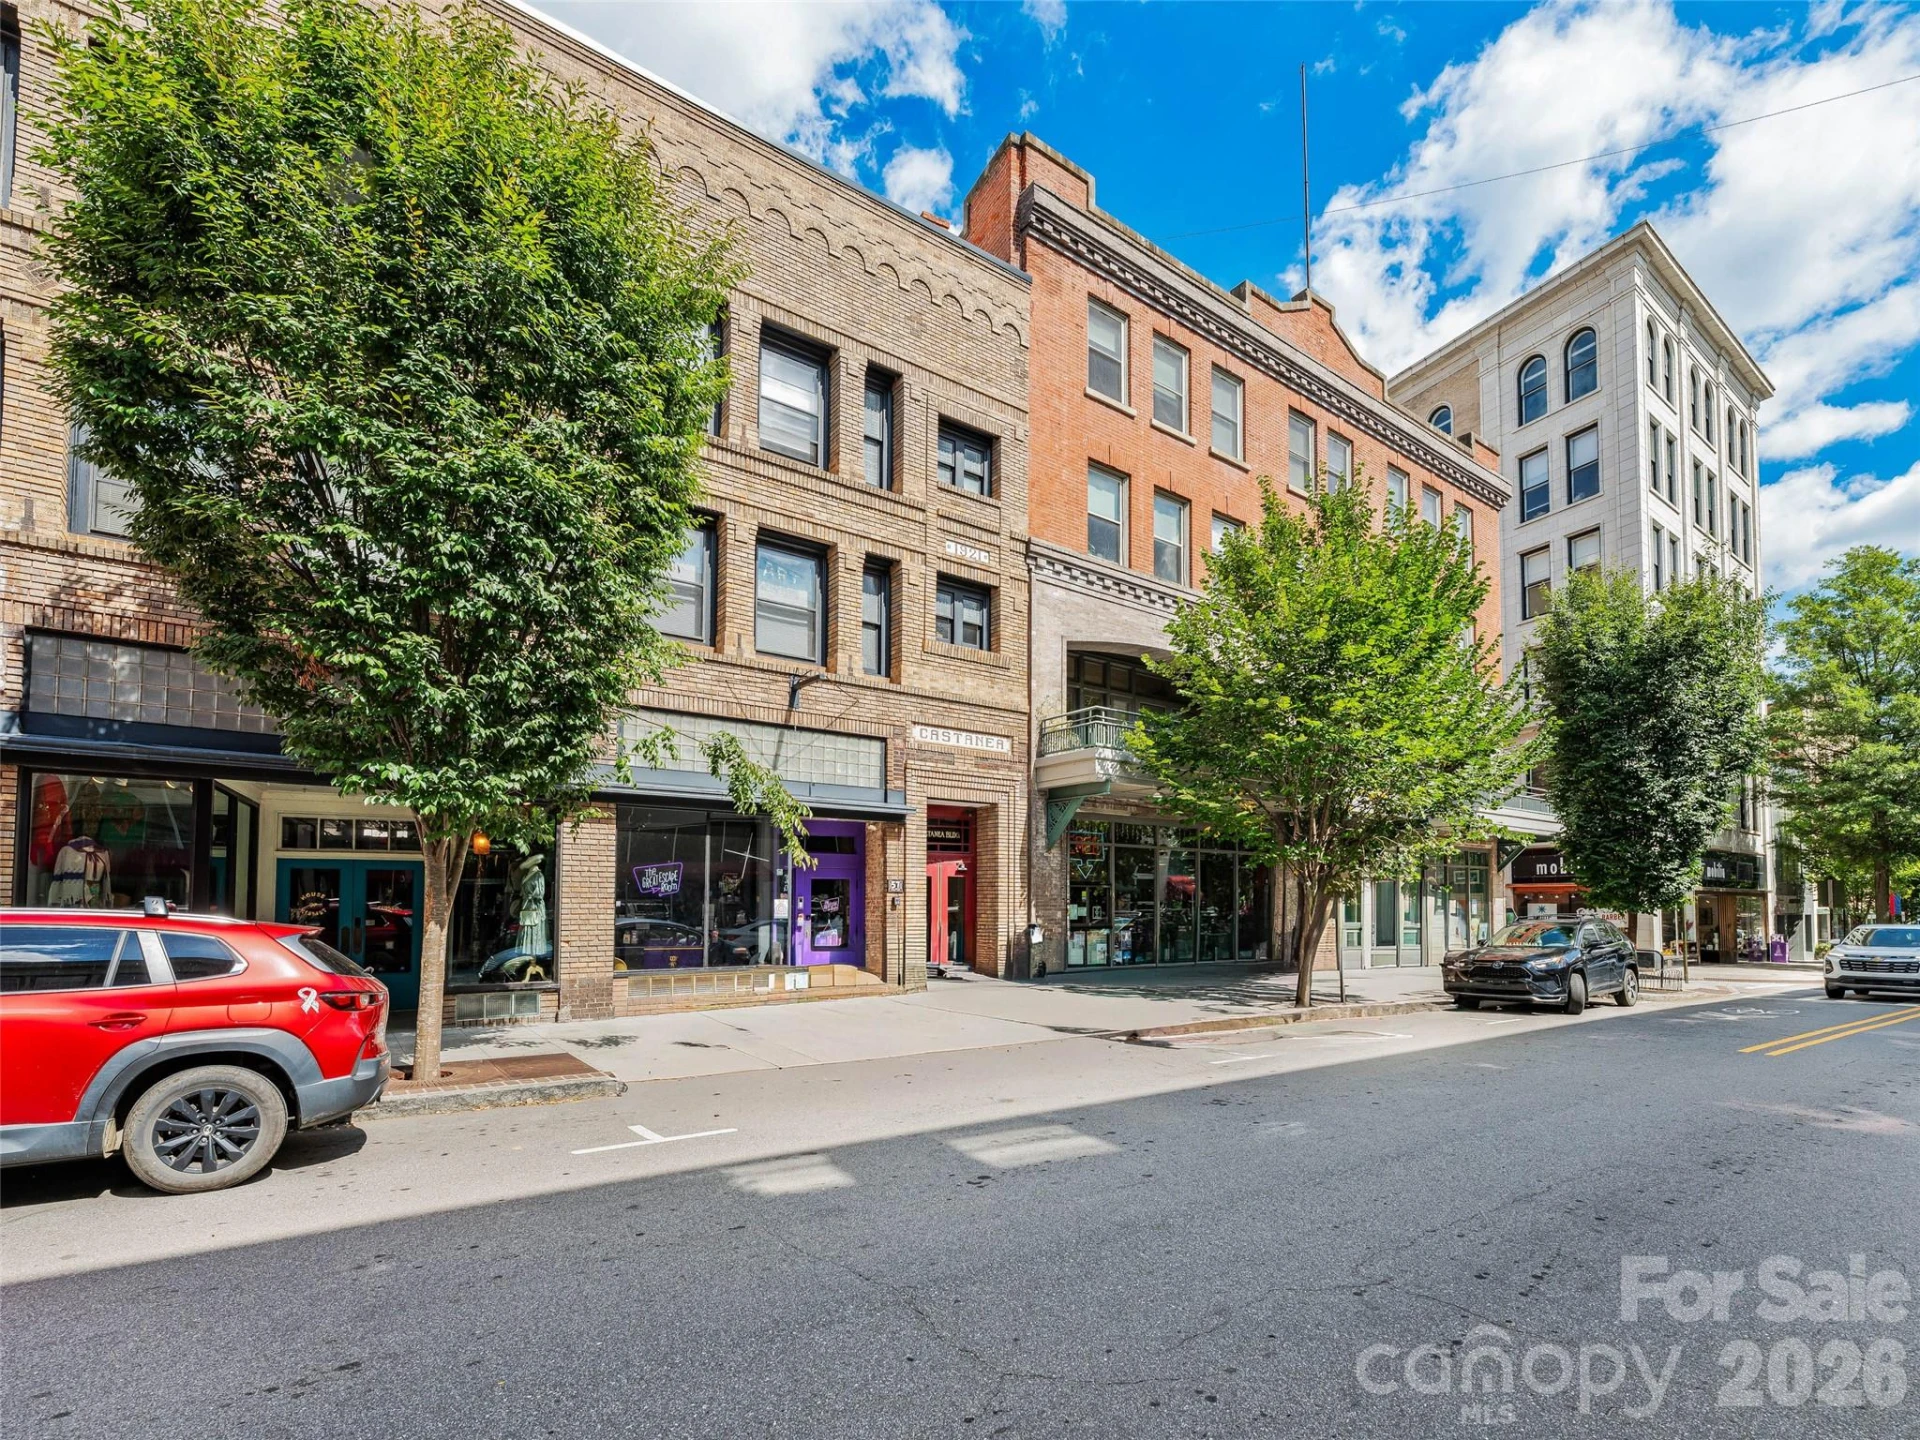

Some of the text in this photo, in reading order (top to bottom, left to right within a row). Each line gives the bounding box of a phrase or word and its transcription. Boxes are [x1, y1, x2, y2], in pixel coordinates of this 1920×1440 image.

[955, 543, 981, 560] 1921
[920, 728, 1004, 749] CASTANEA
[927, 830, 945, 838] TANEA
[300, 892, 326, 900] HOUSE
